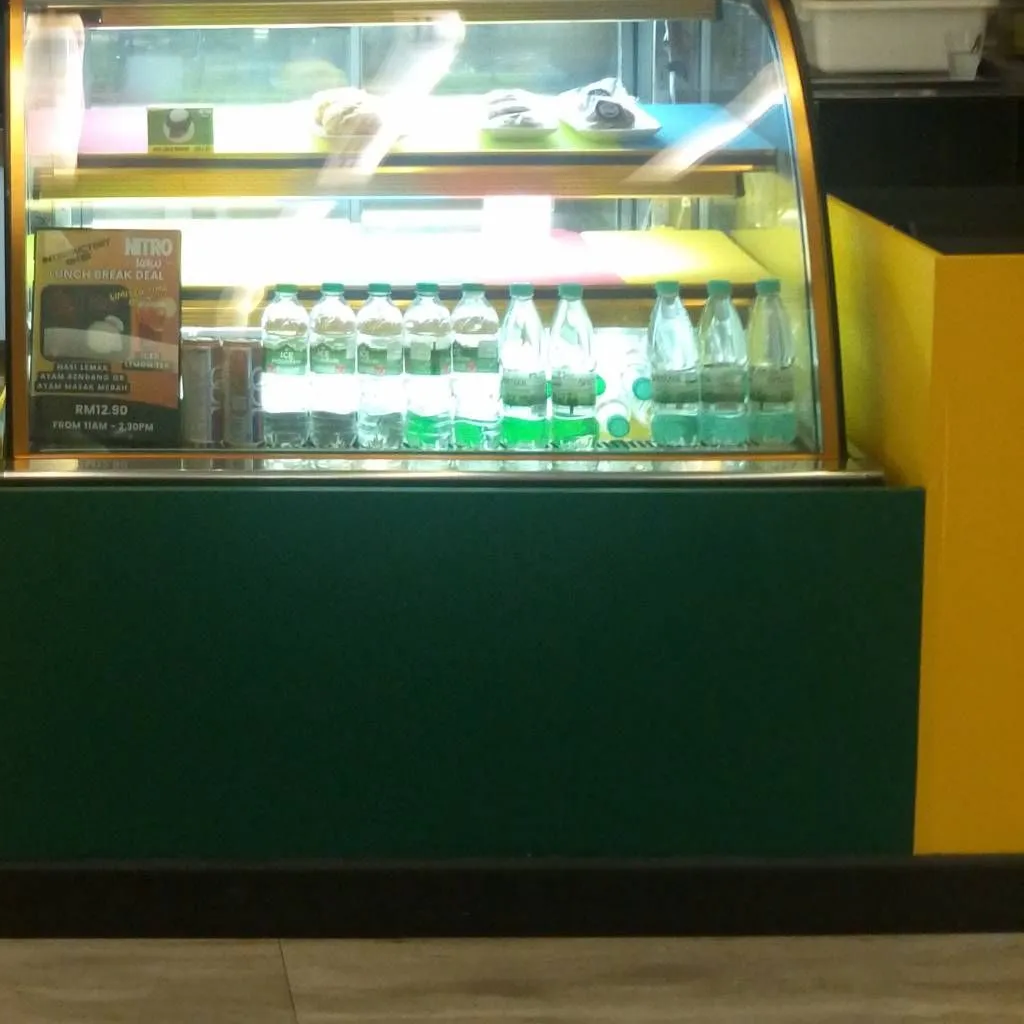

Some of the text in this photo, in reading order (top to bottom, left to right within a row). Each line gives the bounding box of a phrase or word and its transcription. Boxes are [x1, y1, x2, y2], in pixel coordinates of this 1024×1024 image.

[125, 237, 173, 256] NITRO
[94, 270, 164, 280] BREAK DEAL
[52, 420, 80, 429] FROM
